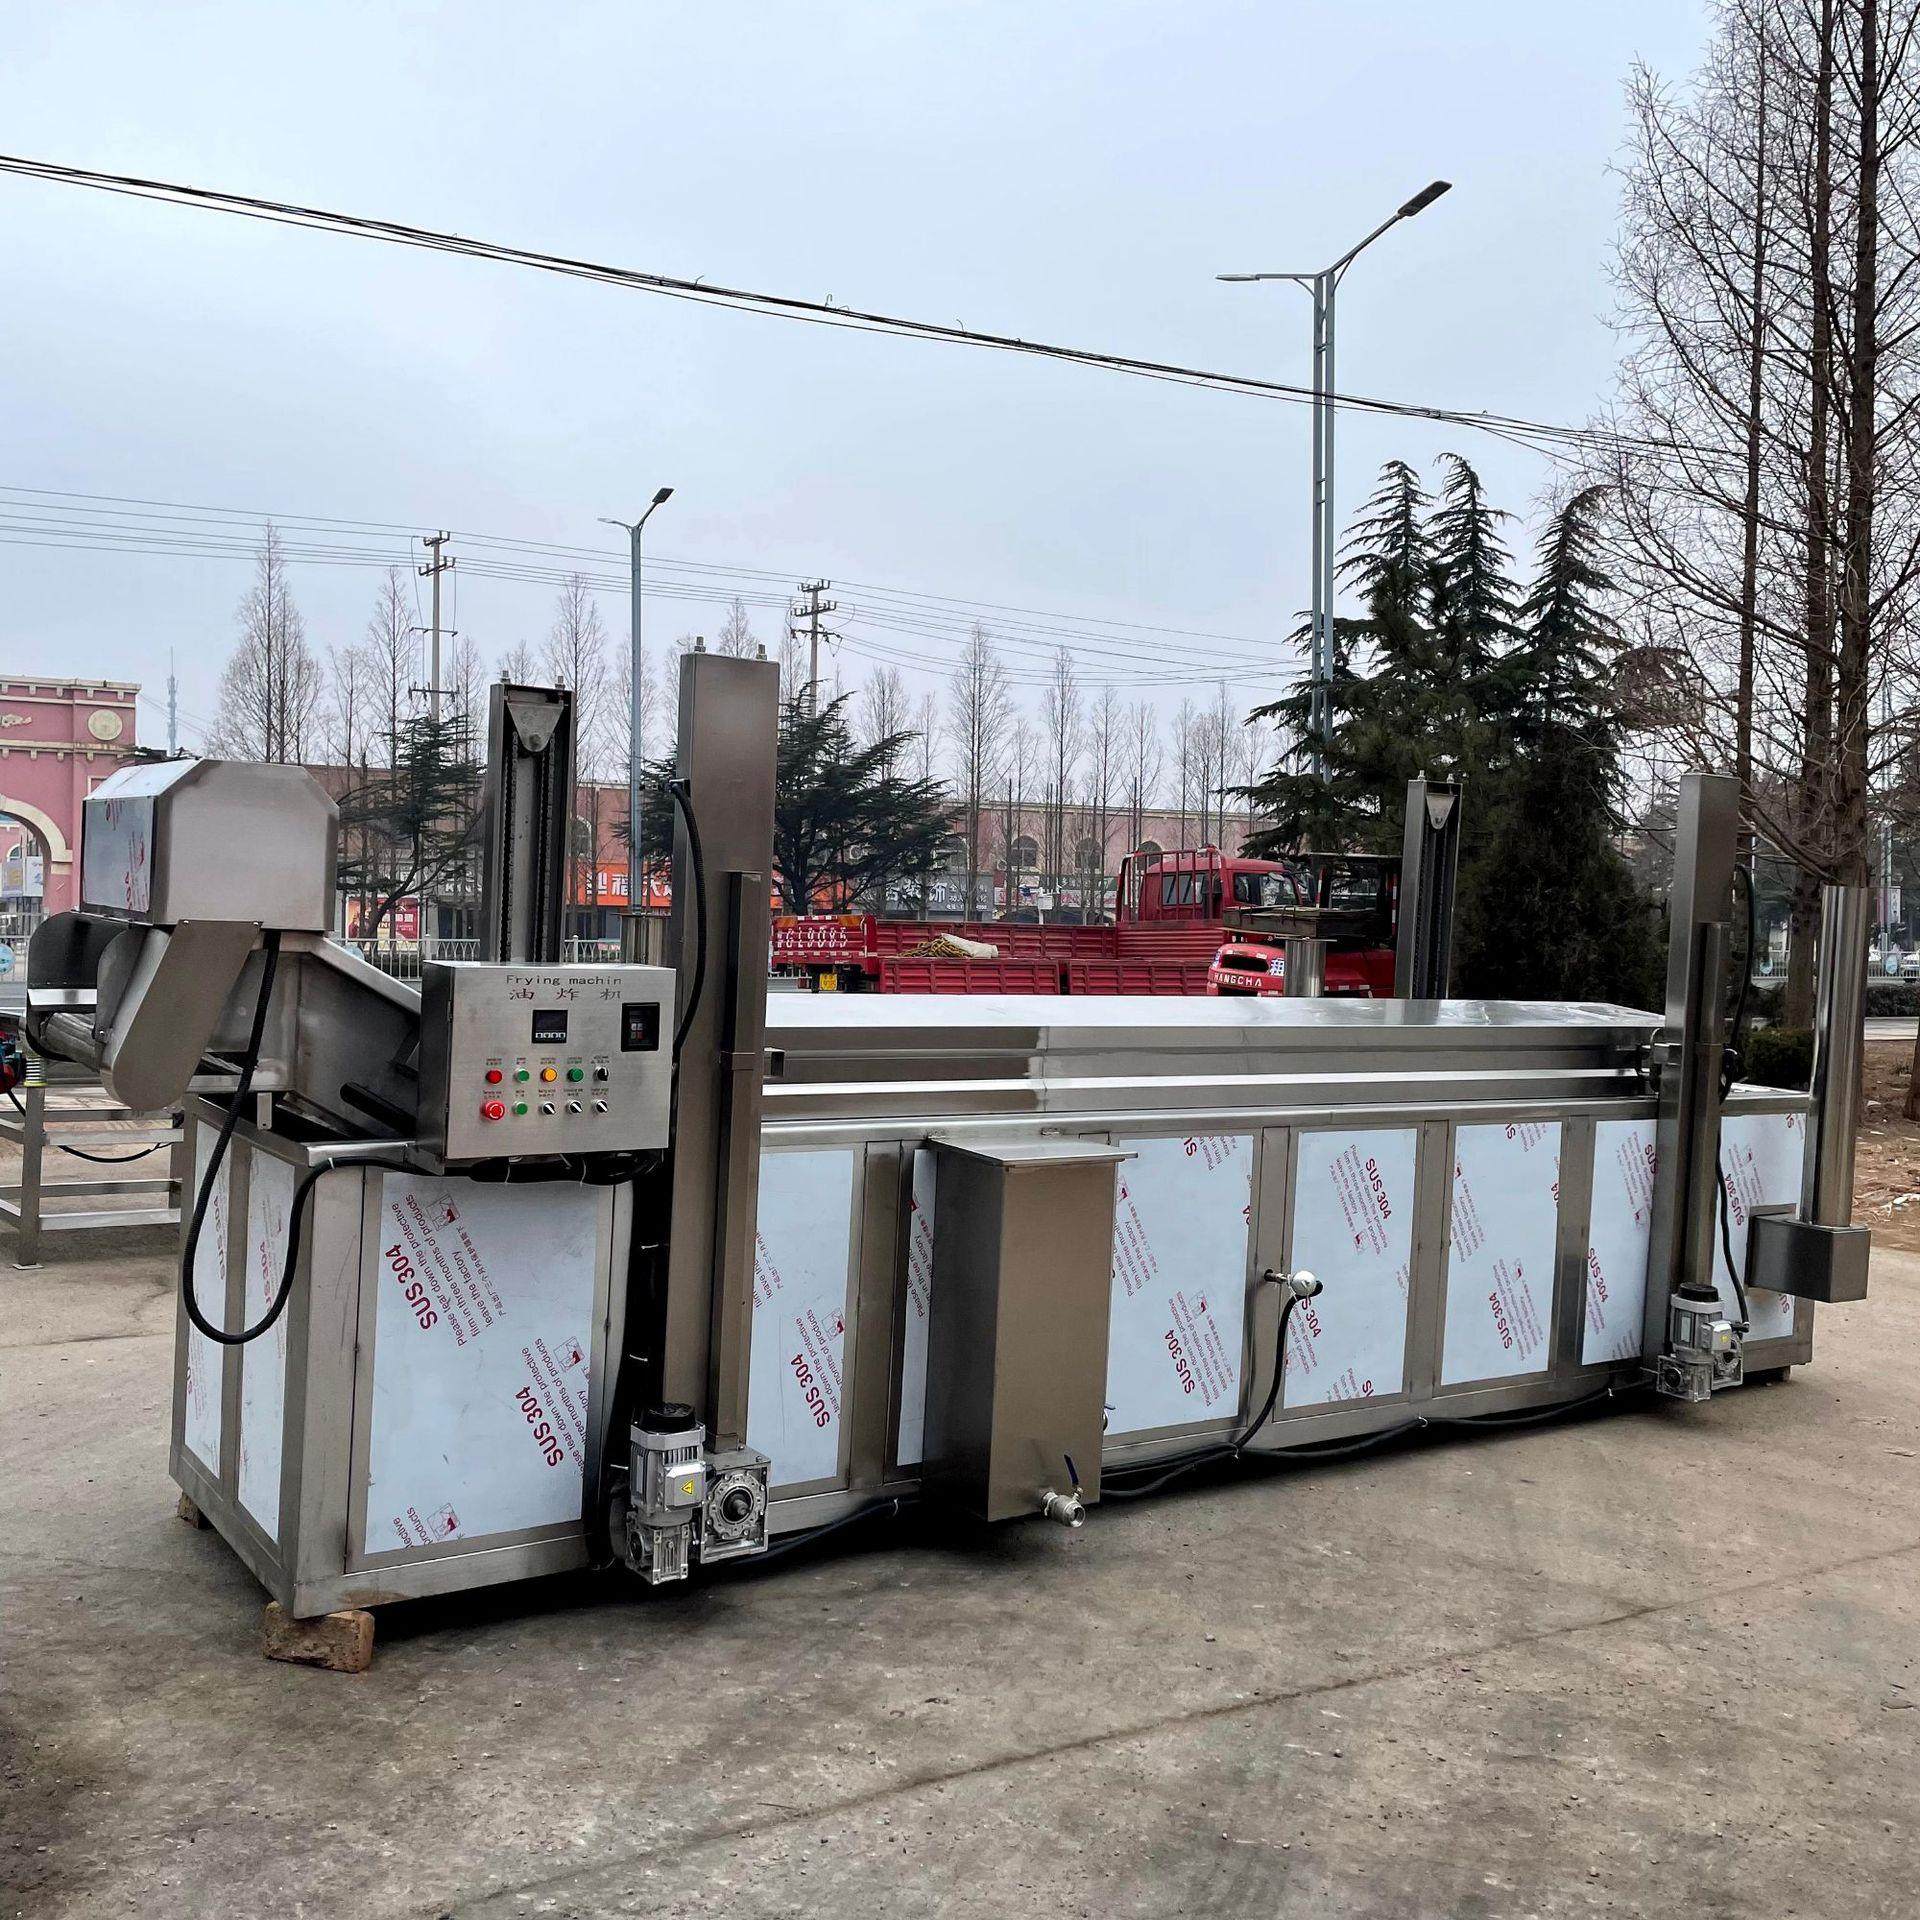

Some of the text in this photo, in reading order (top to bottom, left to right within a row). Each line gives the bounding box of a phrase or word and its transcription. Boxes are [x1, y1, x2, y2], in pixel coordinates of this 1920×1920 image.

[506, 974, 622, 986] Frying machin
[1365, 1159, 1392, 1219] SUS 304
[1725, 1174, 1744, 1226] SUS 304
[392, 1203, 467, 1346] Please tear down the protective
[406, 1194, 480, 1336] film in three months of products
[385, 1244, 438, 1329] SUS 304
[452, 1251, 493, 1327] leave the factory
[759, 1275, 773, 1299] leave
[910, 1289, 925, 1317] Please
[1595, 1278, 1609, 1302] 304
[796, 1318, 818, 1357] protective
[806, 1310, 826, 1344] products
[1305, 1310, 1322, 1337] 304
[1489, 1293, 1513, 1348] SUS 304
[535, 1339, 558, 1376] products
[813, 1359, 822, 1371] the
[821, 1346, 829, 1354] of
[1165, 1330, 1195, 1393] SUS 304
[522, 1347, 548, 1390] protective
[552, 1378, 562, 1387] of
[820, 1372, 832, 1394] down
[543, 1391, 554, 1406] the
[559, 1388, 578, 1420] months
[791, 1354, 830, 1427] SUS 304
[515, 1386, 564, 1466] SUS 304
[551, 1407, 566, 1430] down
[563, 1432, 575, 1449] tear
